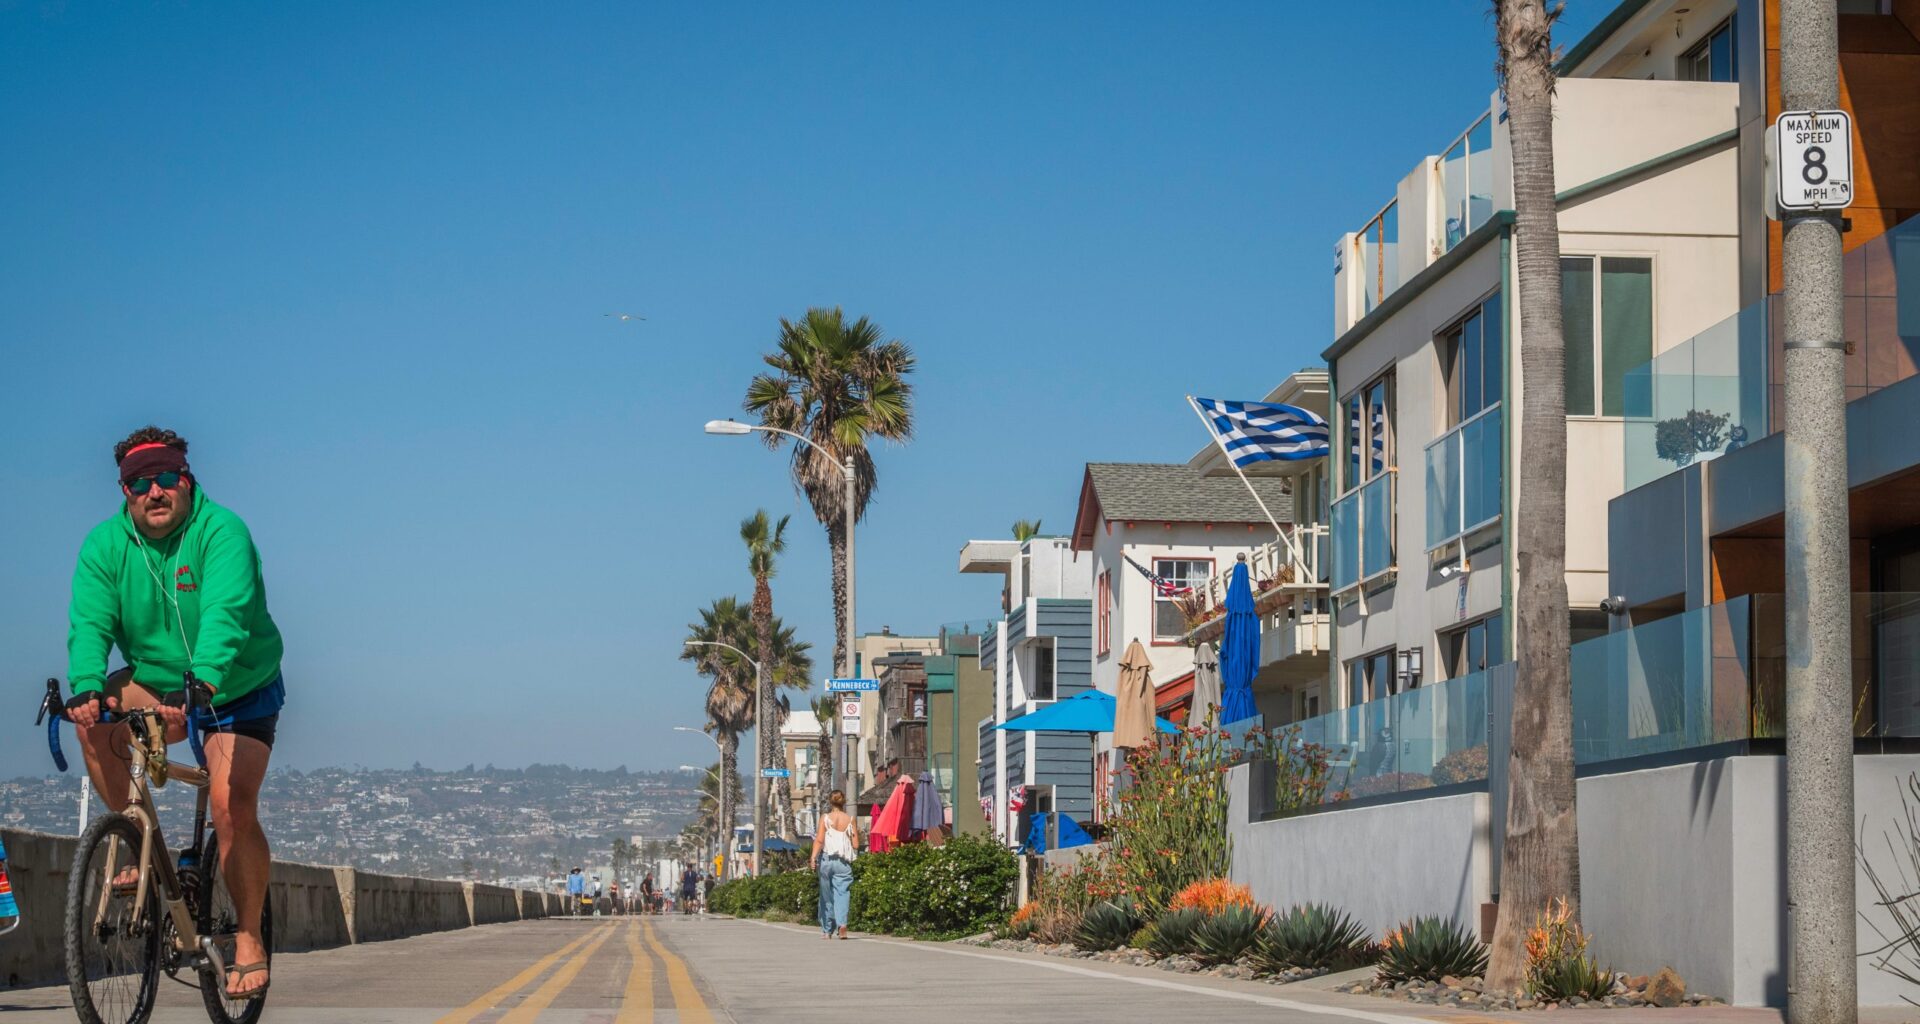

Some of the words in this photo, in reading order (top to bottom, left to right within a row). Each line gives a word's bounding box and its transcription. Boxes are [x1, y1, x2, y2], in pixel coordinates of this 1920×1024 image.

[1787, 119, 1840, 131] MAXIMUM
[1796, 132, 1832, 144] SPEED
[1802, 146, 1828, 185] 8
[1804, 188, 1828, 200] MPH
[832, 681, 870, 690] KENNEBECK
